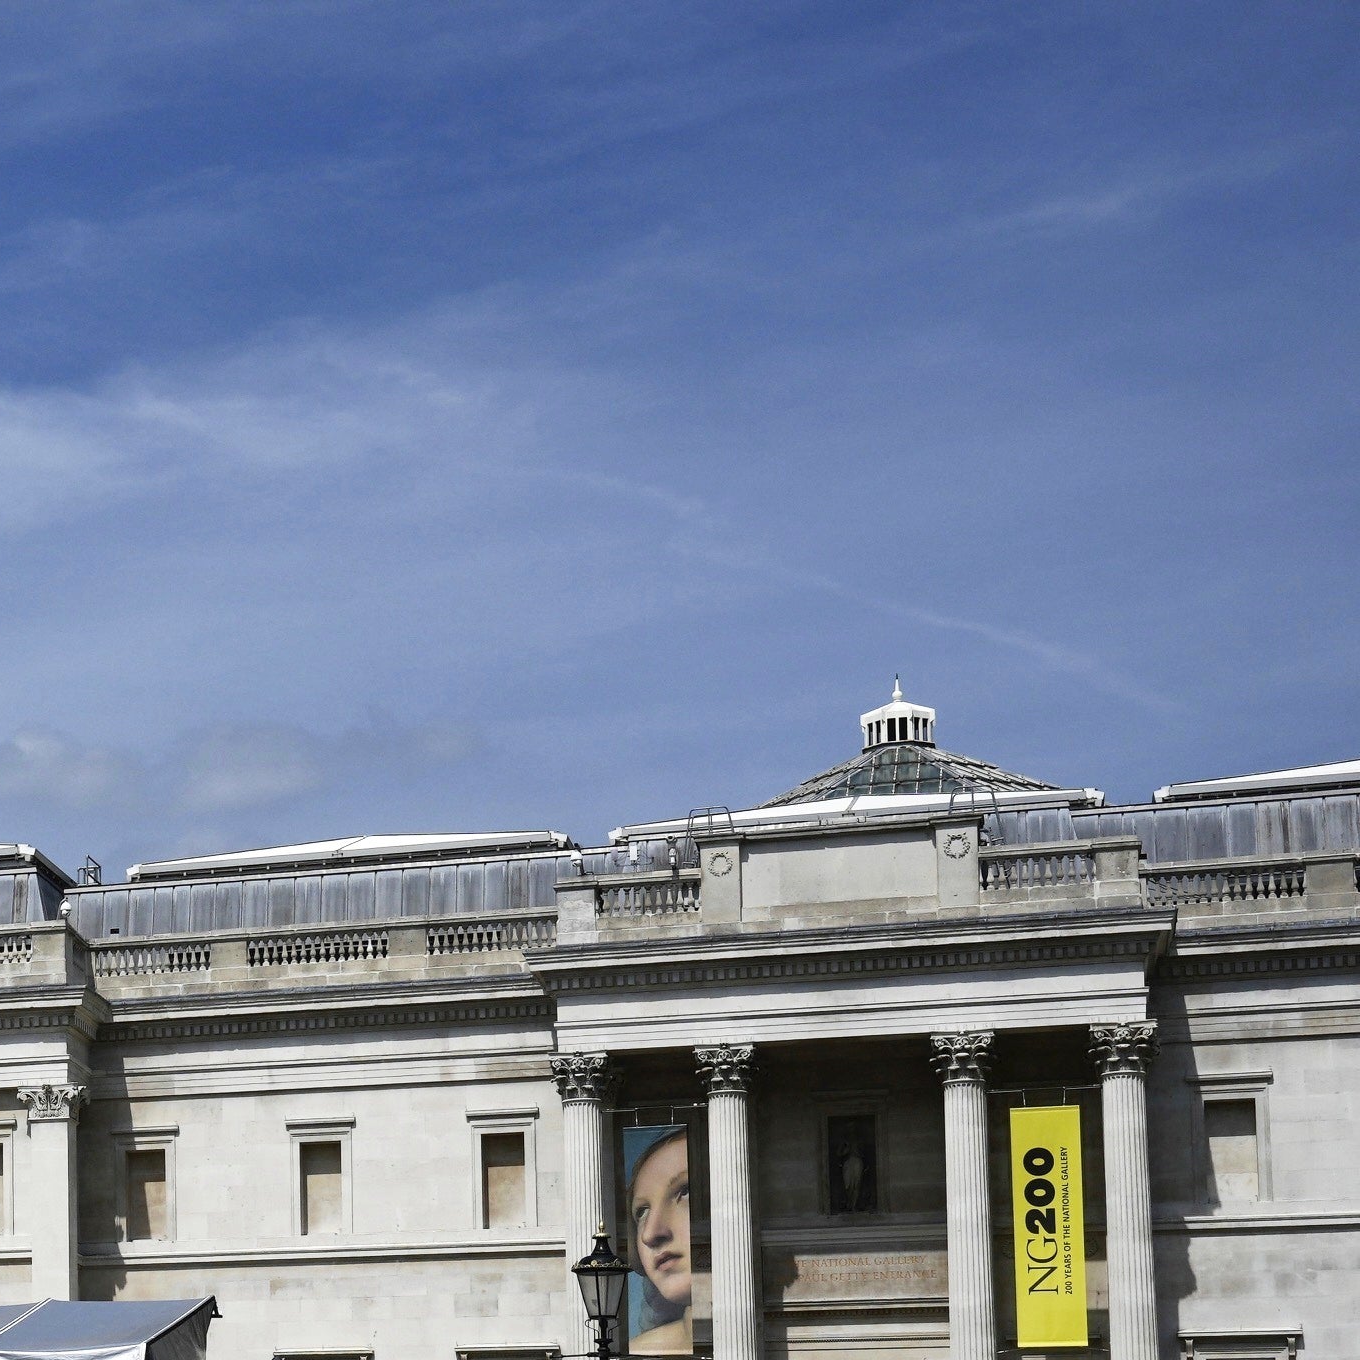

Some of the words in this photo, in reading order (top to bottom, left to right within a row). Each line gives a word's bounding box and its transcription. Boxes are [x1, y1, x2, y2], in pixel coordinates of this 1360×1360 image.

[1060, 1146, 1069, 1181] GALLERY
[1061, 1182, 1070, 1222] NATIONAL
[1023, 1147, 1059, 1296] NG200
[1062, 1224, 1071, 1239] THE
[1063, 1241, 1071, 1252] OF
[811, 1257, 871, 1269] NATIONAL
[874, 1255, 926, 1267] GALLERY
[1063, 1253, 1072, 1279] YEARS
[1064, 1281, 1073, 1295] 200
